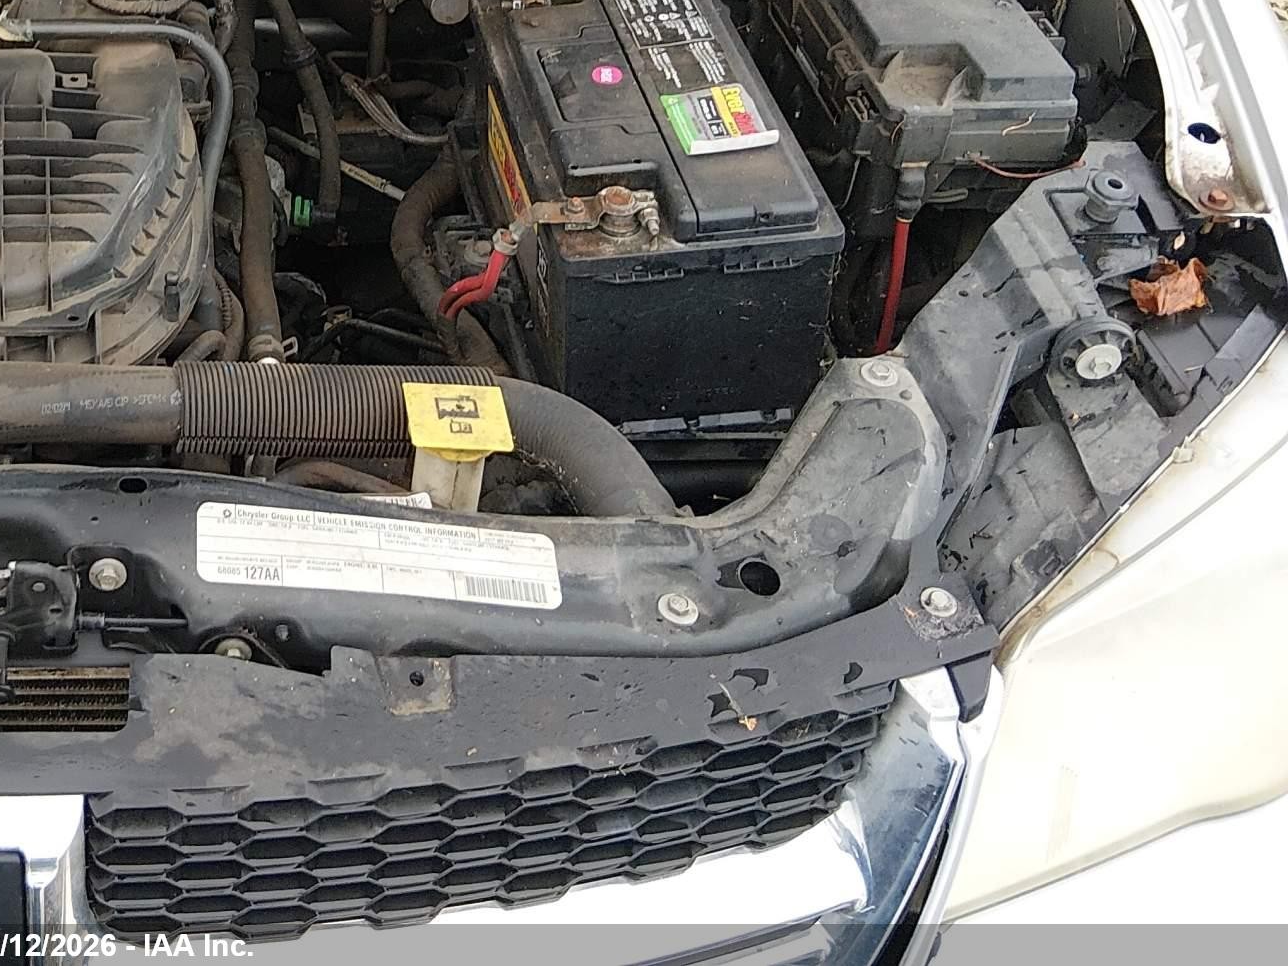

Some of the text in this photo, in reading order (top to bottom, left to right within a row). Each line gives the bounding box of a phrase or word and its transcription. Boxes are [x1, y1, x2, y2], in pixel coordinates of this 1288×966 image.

[237, 509, 311, 523] Chrysler Group LLC
[317, 517, 347, 527] VEHICLE
[350, 519, 386, 531] EMISSION
[388, 523, 422, 535] CONTROL
[424, 527, 477, 540] INFORMATION
[244, 566, 281, 582] 127AA
